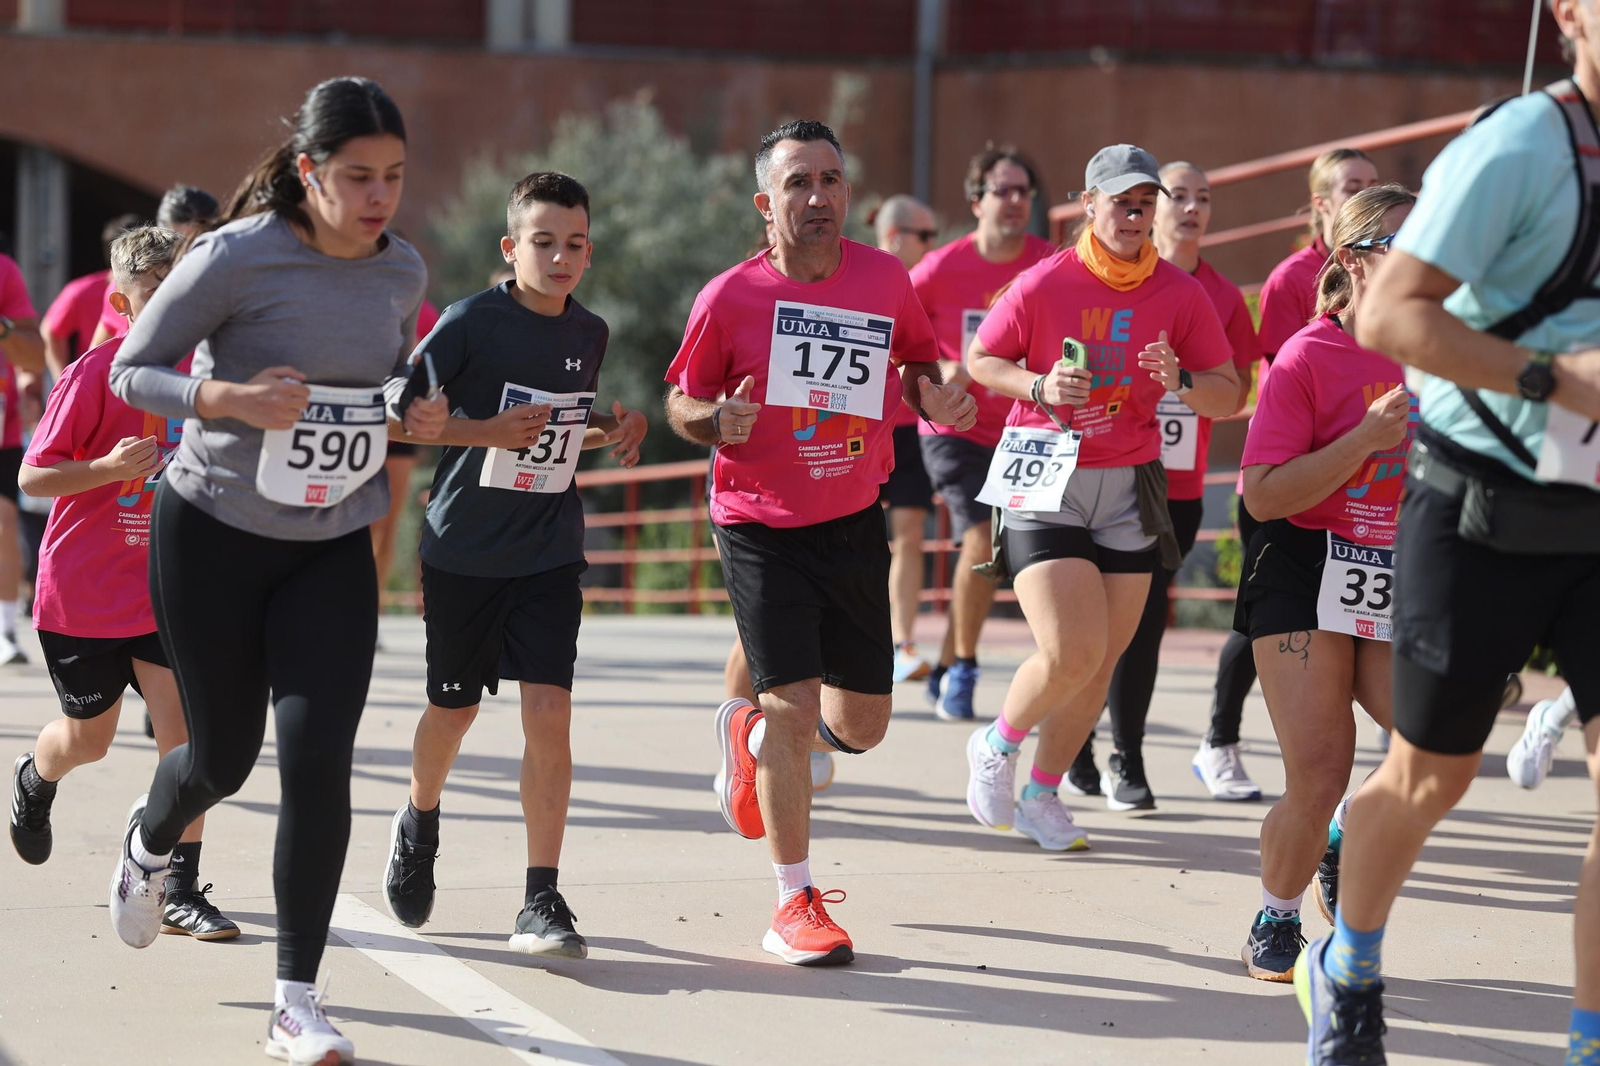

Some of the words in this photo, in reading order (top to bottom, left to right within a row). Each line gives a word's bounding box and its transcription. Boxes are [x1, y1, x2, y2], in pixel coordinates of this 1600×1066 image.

[780, 319, 832, 337] UMA
[1081, 307, 1133, 342] WE
[792, 341, 870, 385] 175
[810, 393, 829, 405] WE
[831, 392, 847, 400] RUN
[300, 403, 337, 422] MA
[287, 428, 372, 472] 590
[798, 444, 820, 452] CARRERA
[821, 442, 844, 450] POPULAR
[1002, 439, 1038, 454] UMA
[803, 450, 829, 458] BENEFICIO
[825, 464, 854, 473] UNIVERSIDAD
[1002, 457, 1063, 488] 498
[517, 475, 534, 486] WE
[1346, 501, 1369, 510] CARRERA
[118, 511, 140, 519] CARRERA
[1349, 508, 1377, 517] BENEFICIO
[1334, 543, 1385, 566] UMA
[1356, 622, 1374, 634] WE
[1376, 622, 1392, 630] RUN
